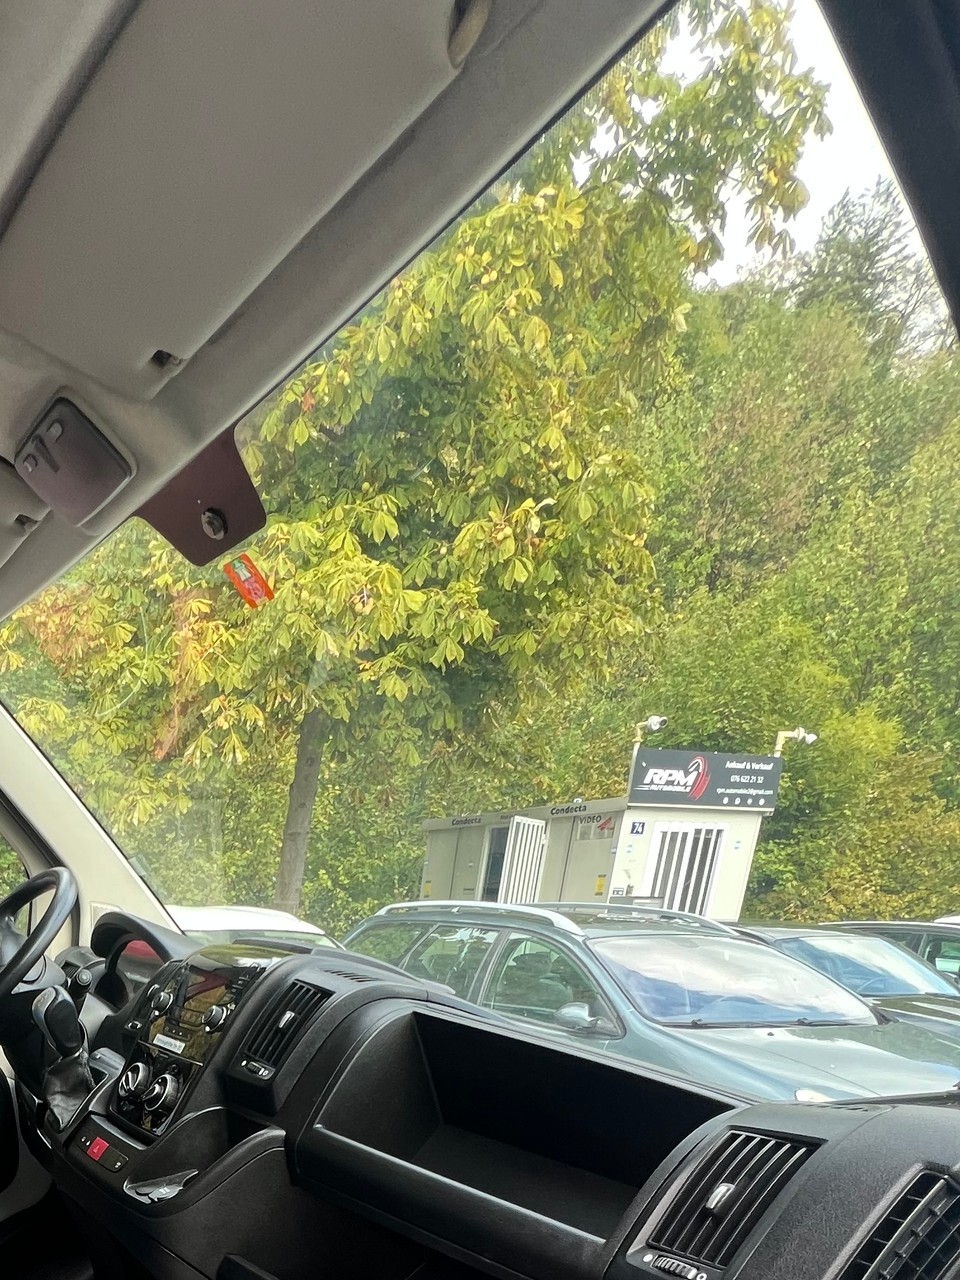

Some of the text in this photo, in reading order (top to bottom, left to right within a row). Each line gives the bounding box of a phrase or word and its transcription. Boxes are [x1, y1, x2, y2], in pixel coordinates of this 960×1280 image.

[643, 769, 699, 785] RPM
[550, 804, 587, 815] Condecta
[451, 817, 482, 826] Condecta
[580, 815, 602, 825] VIDEO
[633, 823, 643, 834] 74
